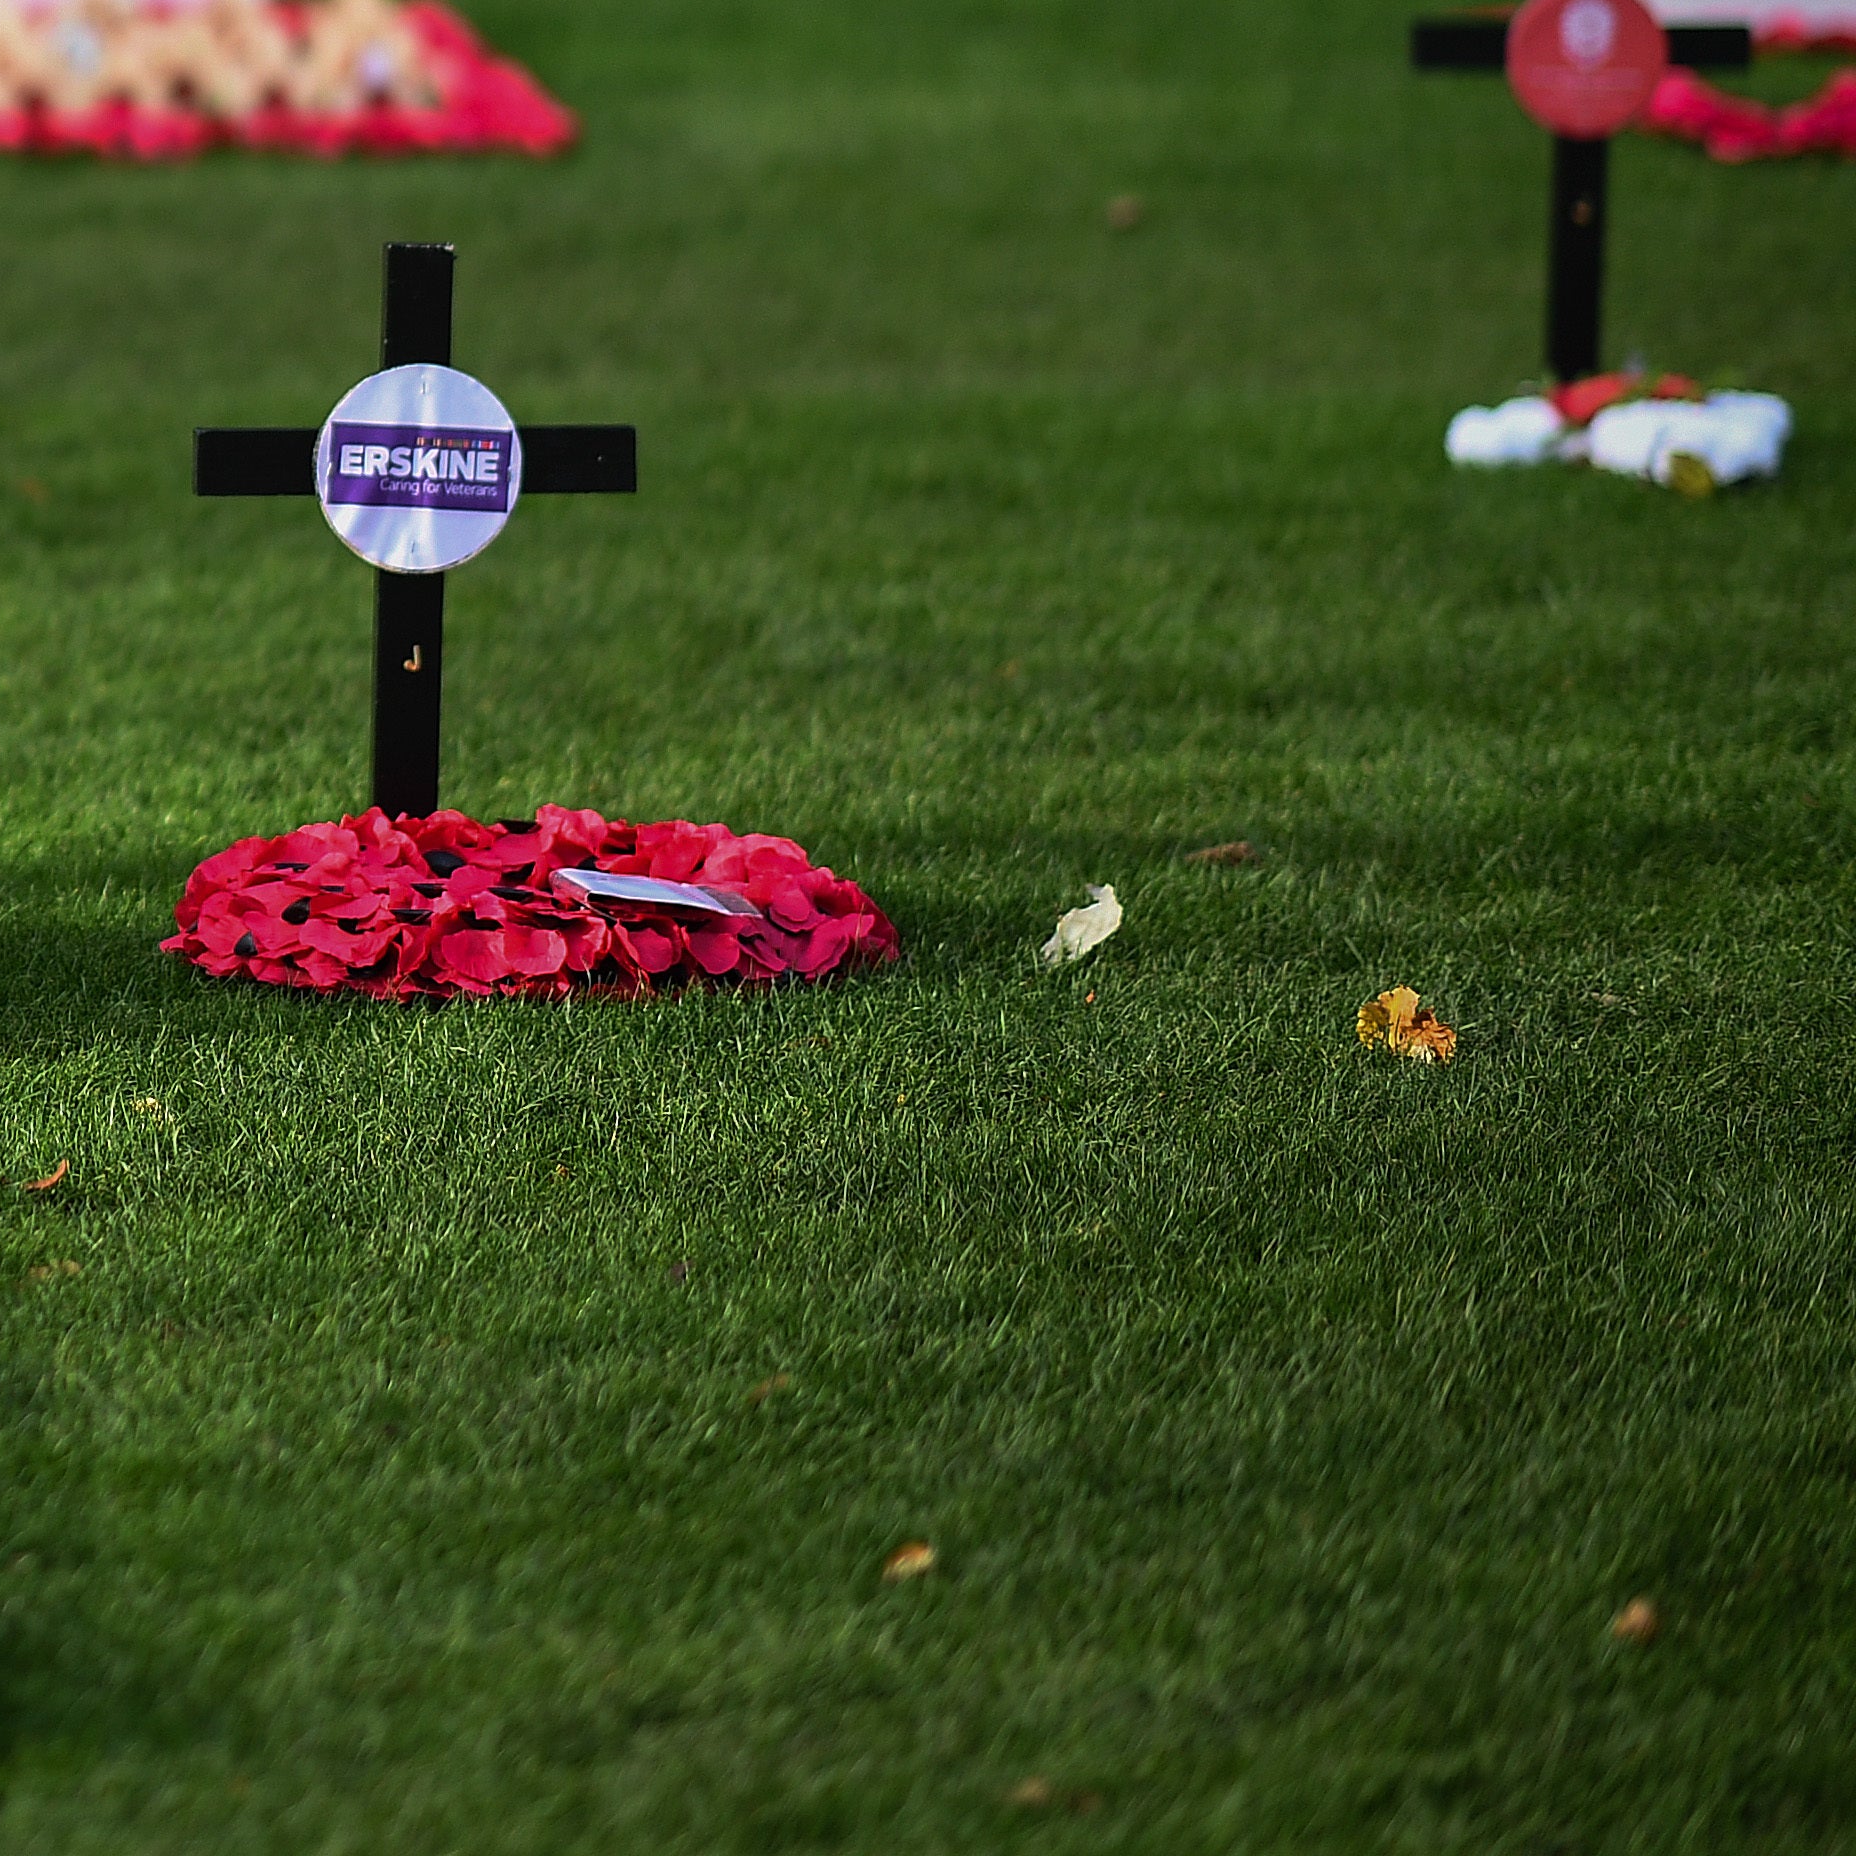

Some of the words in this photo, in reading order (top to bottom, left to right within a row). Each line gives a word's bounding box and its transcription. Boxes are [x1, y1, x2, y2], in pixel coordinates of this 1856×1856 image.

[340, 444, 499, 482] ERSKINE
[380, 478, 419, 496] Caring
[422, 479, 442, 494] for
[444, 482, 498, 497] Veterans
